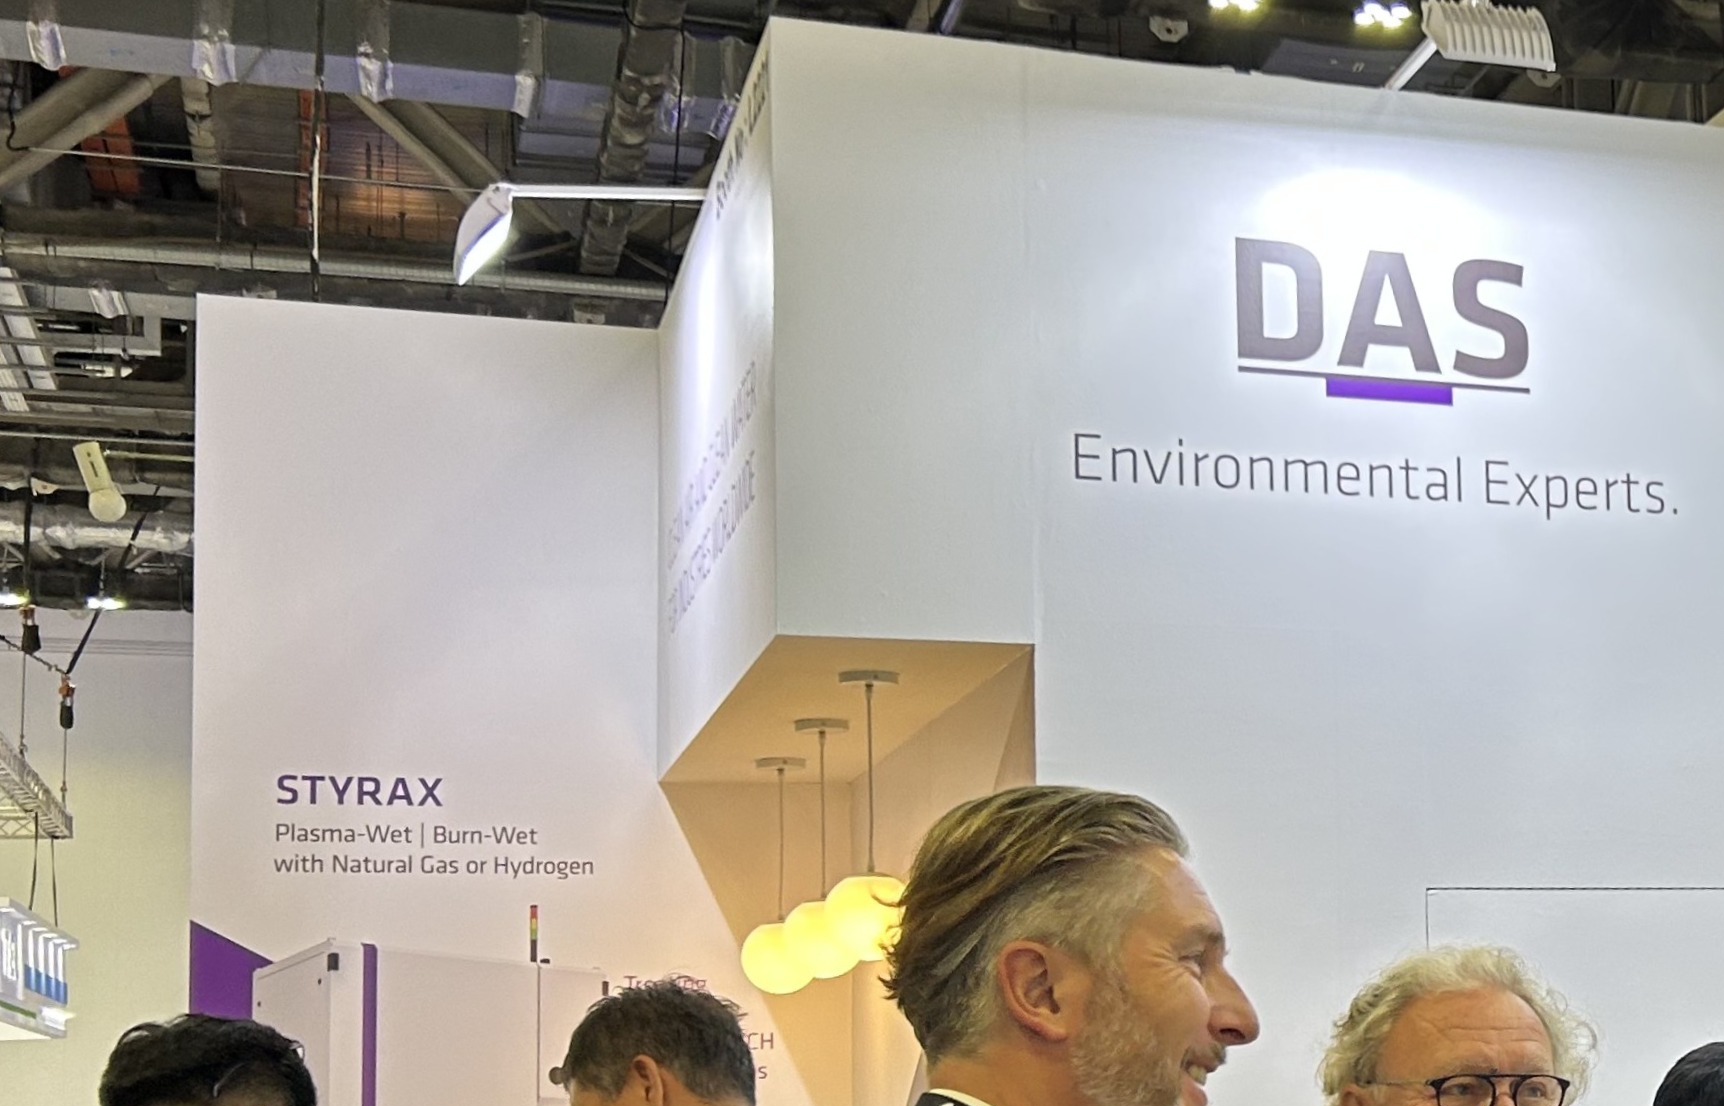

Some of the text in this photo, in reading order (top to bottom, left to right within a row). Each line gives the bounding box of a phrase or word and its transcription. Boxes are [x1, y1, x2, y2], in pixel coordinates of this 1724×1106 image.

[1234, 236, 1531, 380] DAS
[1072, 431, 1680, 521] Environmental Experts.
[276, 774, 444, 808] STYRAX
[274, 822, 413, 845] Plasma-Wet
[433, 825, 539, 846] Burn-Wet
[273, 853, 595, 881] with Natural Gas or Hydrogen
